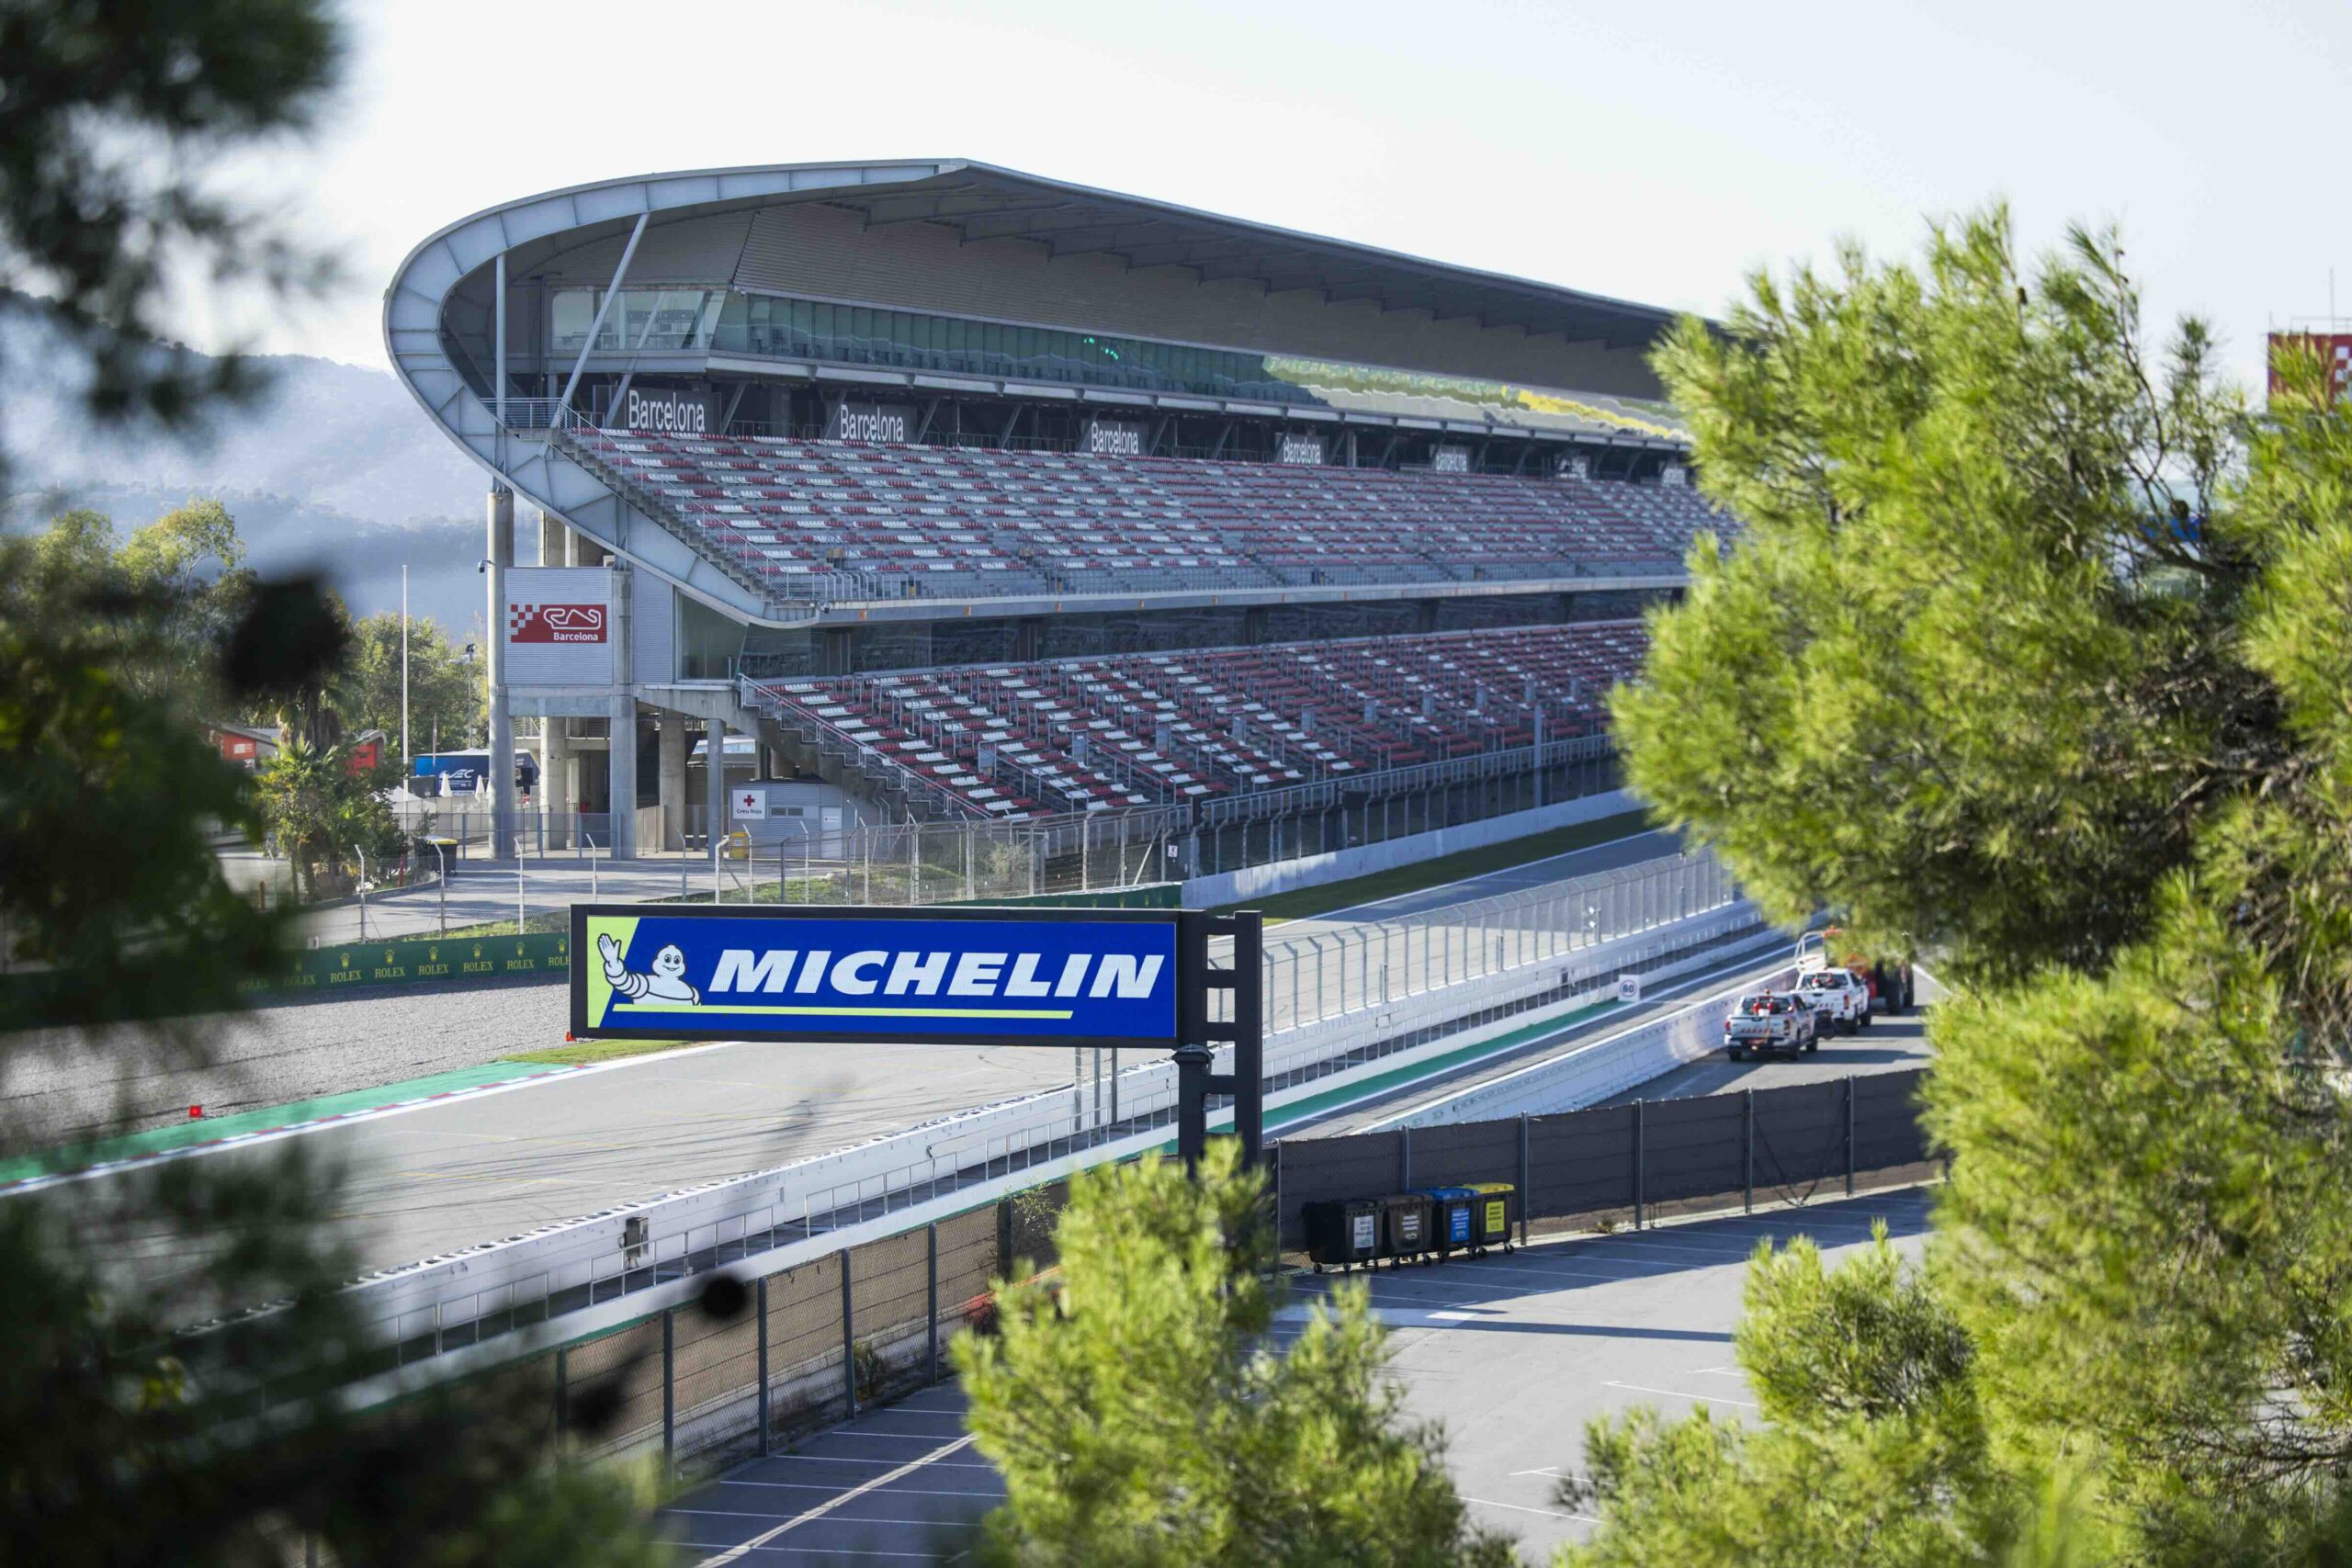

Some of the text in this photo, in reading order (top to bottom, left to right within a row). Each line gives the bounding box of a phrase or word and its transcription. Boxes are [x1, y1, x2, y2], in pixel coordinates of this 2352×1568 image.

[628, 389, 705, 432] Barcelona
[840, 404, 904, 442] Barcelona
[1091, 422, 1139, 455] Barcelona
[553, 631, 599, 641] Barcelona
[462, 961, 493, 973] ROLEX
[506, 959, 535, 971] ROLEX
[548, 956, 571, 966] ROLE
[374, 966, 405, 979] ROLEX
[418, 964, 449, 976] ROLEX
[707, 948, 1165, 999] MICHELIN
[331, 970, 362, 984] ROLEX
[1623, 985, 1634, 993] 60
